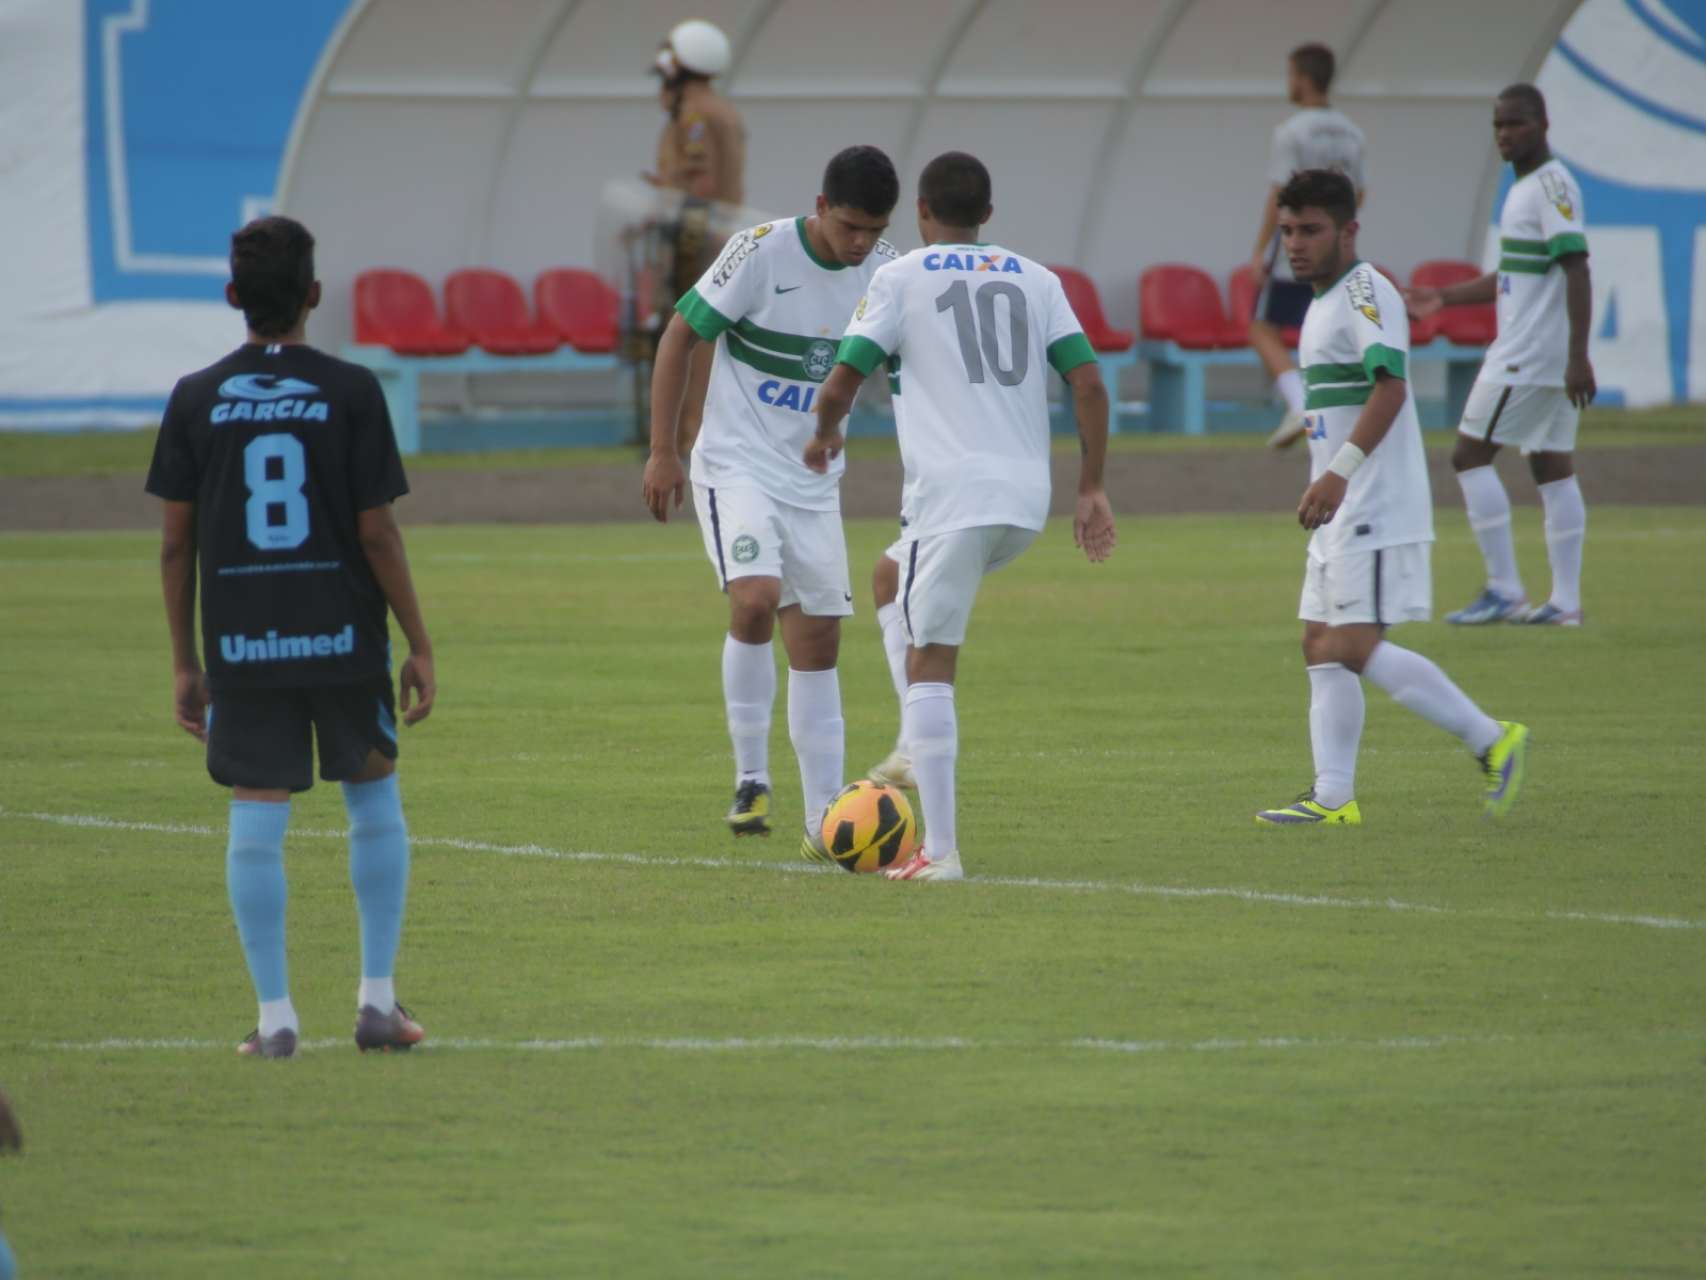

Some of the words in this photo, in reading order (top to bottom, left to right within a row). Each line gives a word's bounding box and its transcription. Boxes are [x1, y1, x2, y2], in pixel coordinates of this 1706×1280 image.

[923, 253, 1023, 274] CAIXA
[935, 279, 1029, 387] 10
[210, 399, 329, 423] GARCIA
[757, 380, 816, 413] CAI
[244, 432, 311, 550] 8
[220, 624, 355, 662] Unimed
